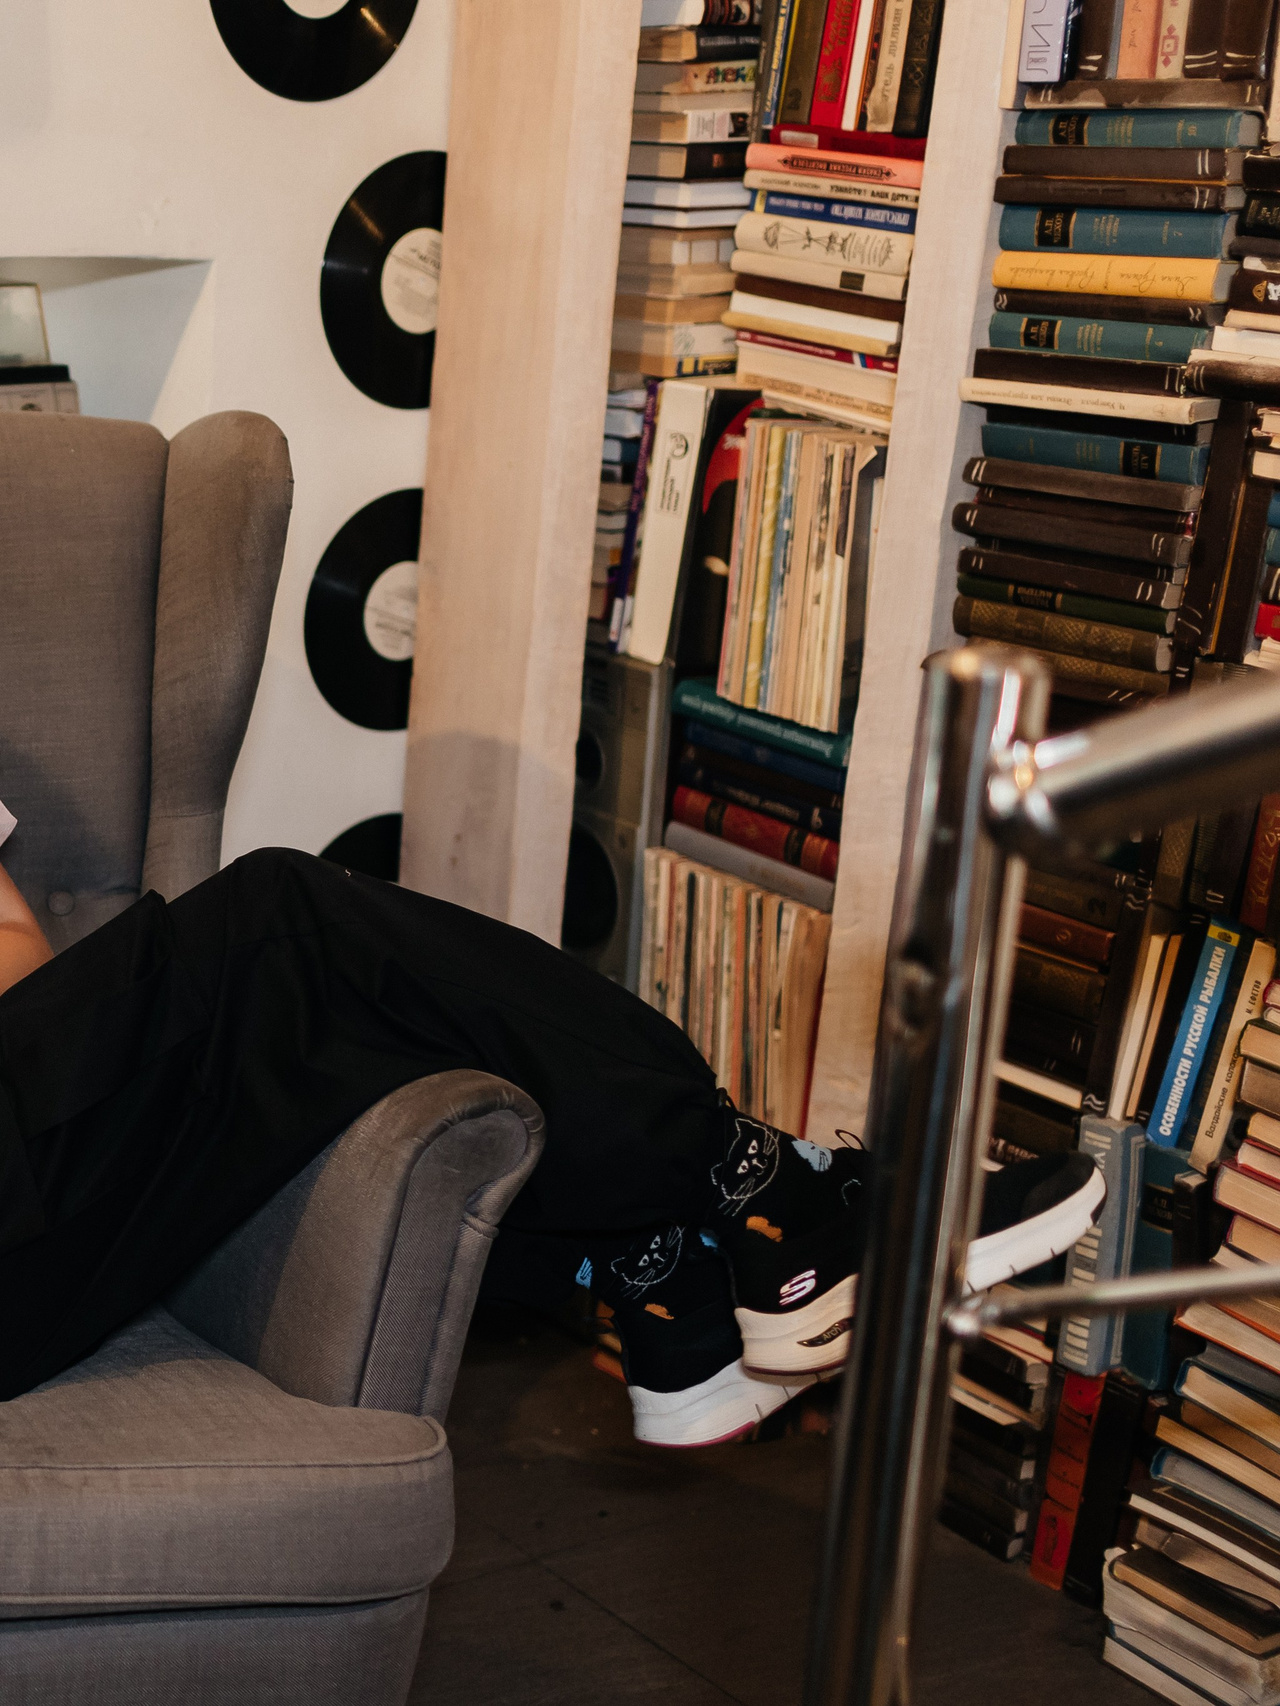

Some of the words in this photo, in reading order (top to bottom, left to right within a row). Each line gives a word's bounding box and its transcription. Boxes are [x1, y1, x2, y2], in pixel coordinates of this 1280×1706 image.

[1159, 1056, 1192, 1137] ОСОБЕННОСТИ
[1182, 1004, 1209, 1058] РУССКОЙ
[1199, 946, 1227, 1004] РЫБАЛКИ
[1205, 1087, 1228, 1139] Валдайские
[1225, 1048, 1240, 1084] колоко
[822, 1326, 842, 1342] Arch
